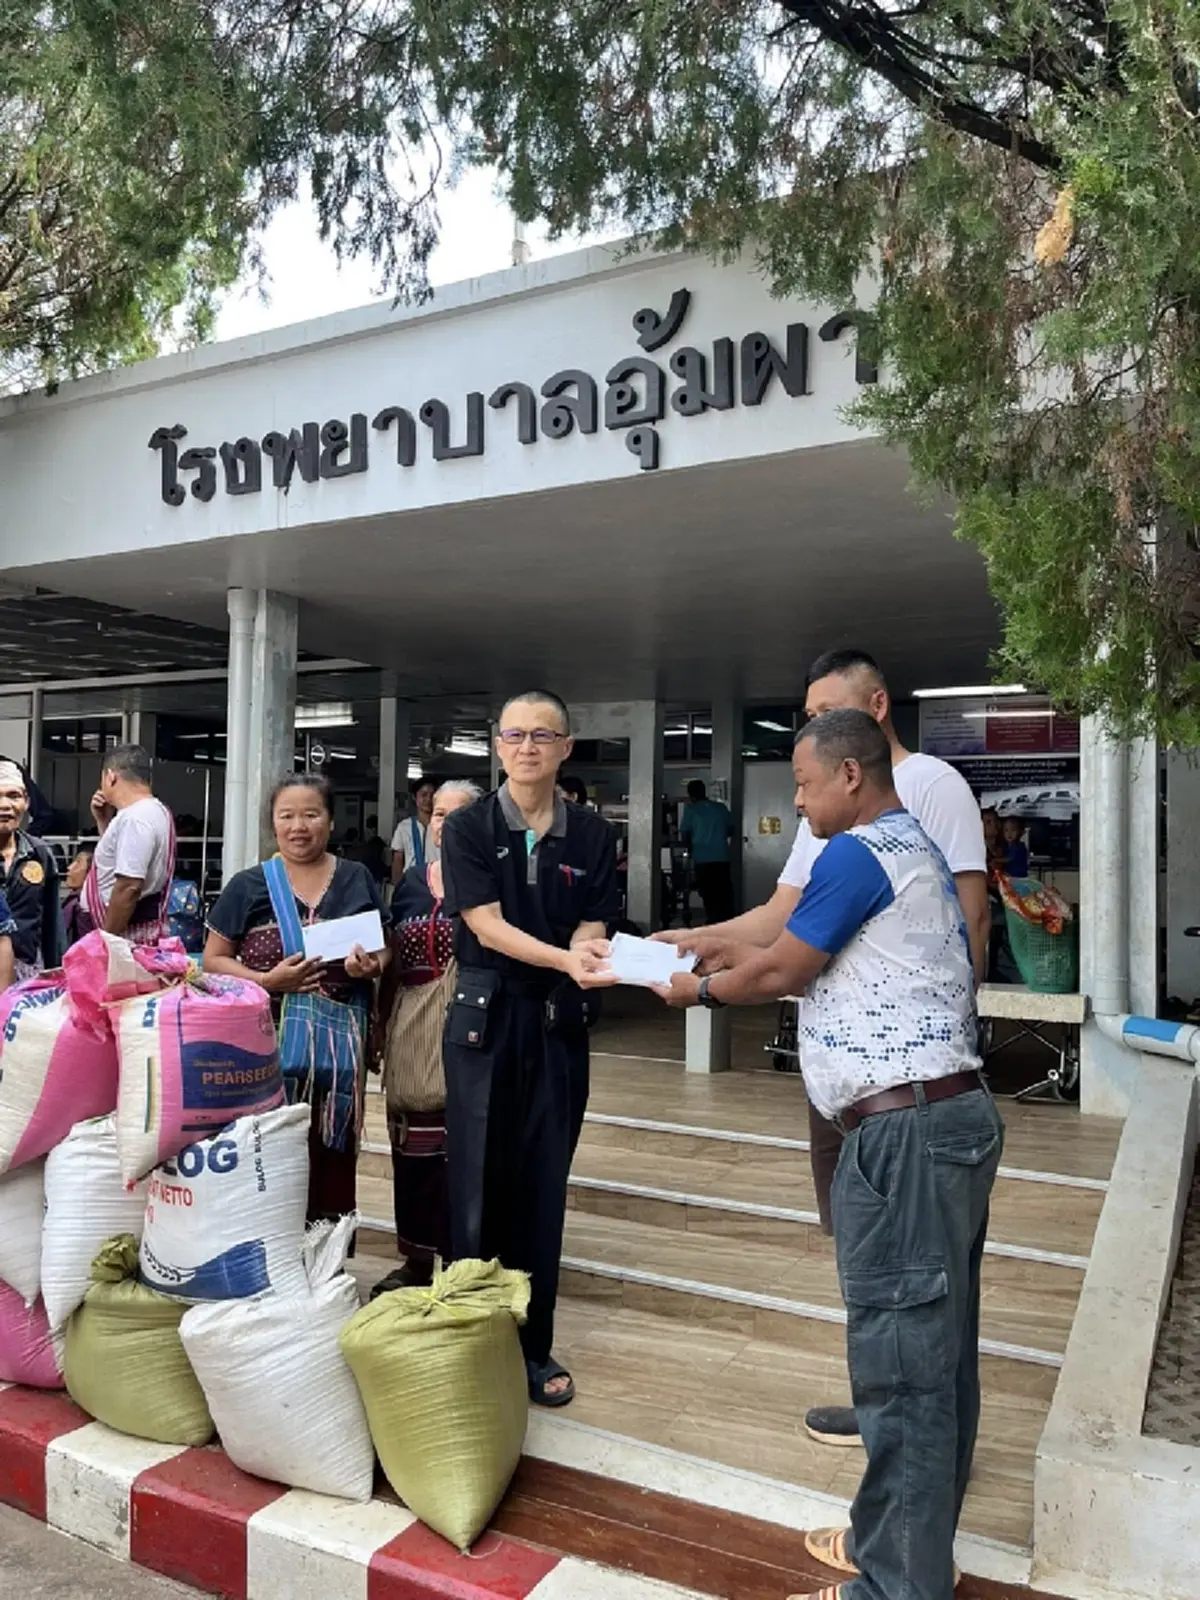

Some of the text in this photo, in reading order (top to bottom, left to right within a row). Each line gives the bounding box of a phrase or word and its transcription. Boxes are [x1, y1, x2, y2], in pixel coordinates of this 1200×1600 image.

[148, 287, 878, 507] โรงพยาบาลอุ้มผา
